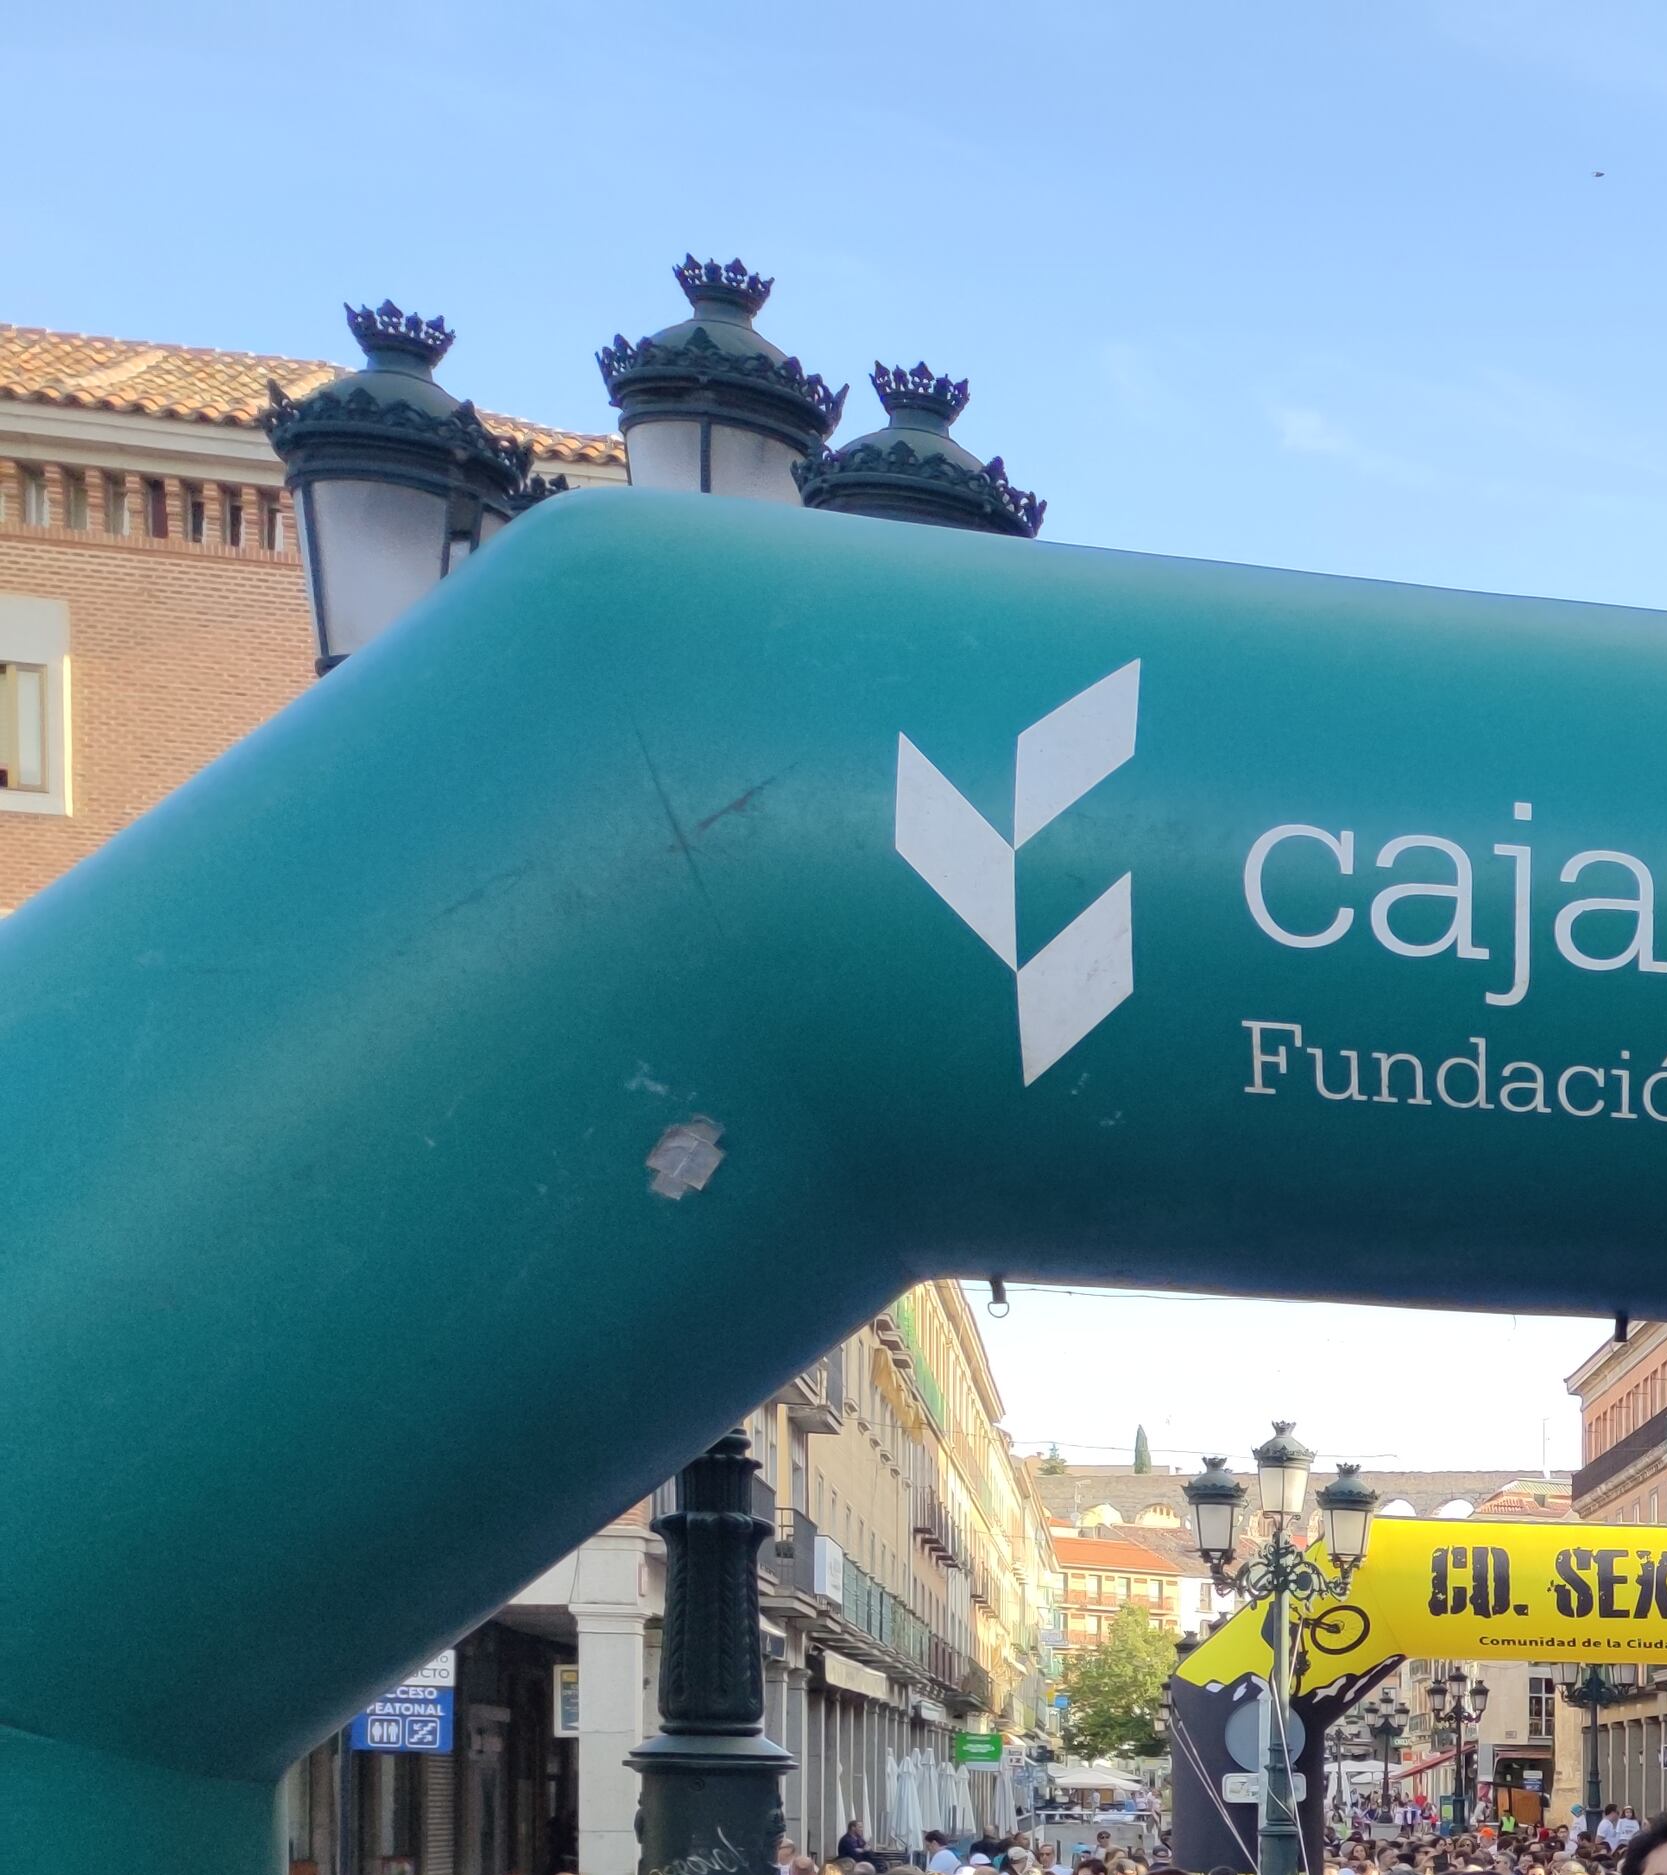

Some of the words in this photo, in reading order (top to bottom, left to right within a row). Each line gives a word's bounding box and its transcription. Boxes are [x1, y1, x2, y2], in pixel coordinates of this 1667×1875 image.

[1427, 1545, 1529, 1618] CD.
[1479, 1636, 1577, 1648] Comunidad
[1581, 1637, 1602, 1649] de
[1606, 1637, 1621, 1650] la
